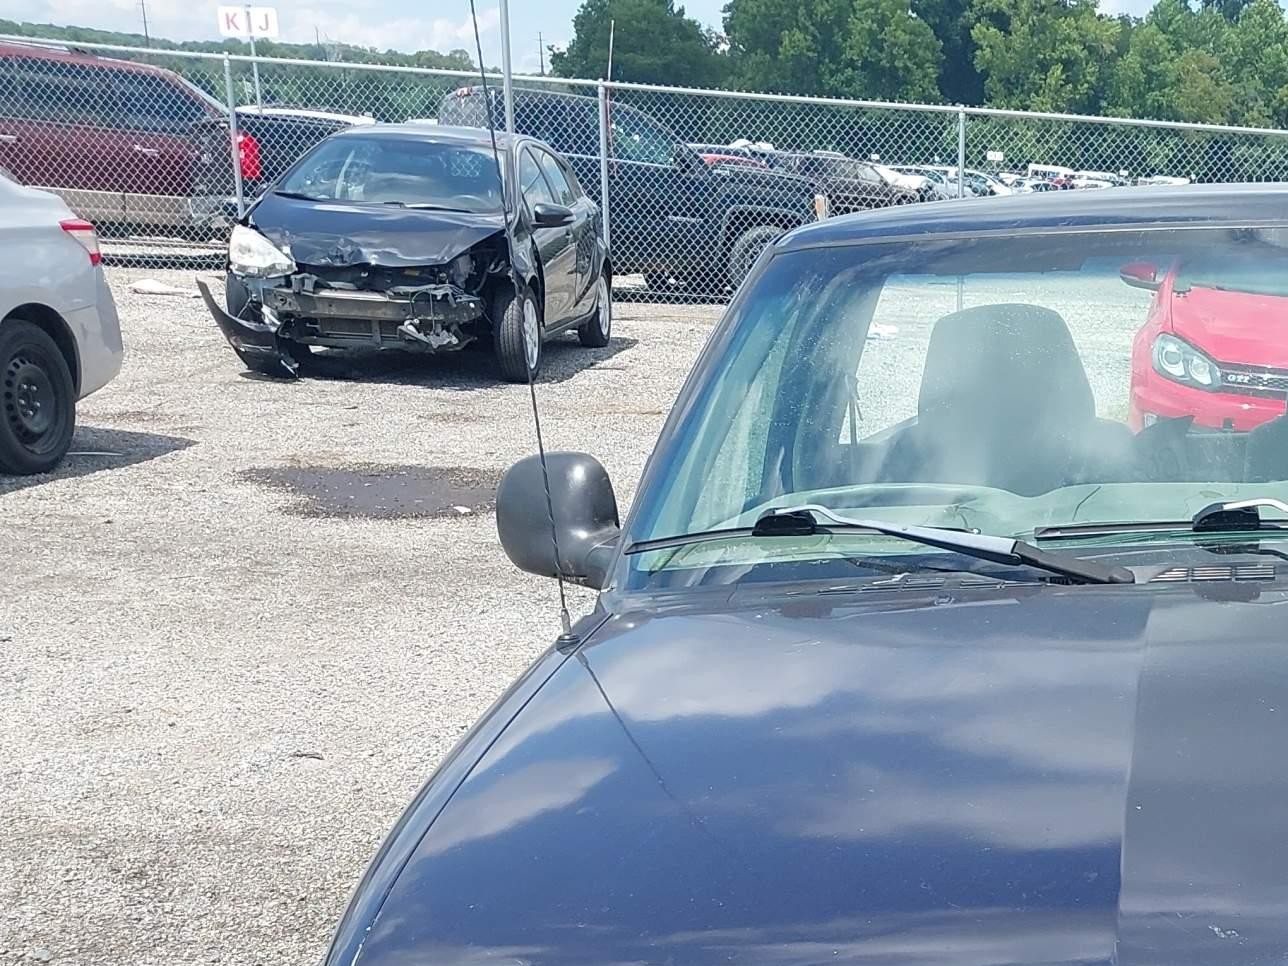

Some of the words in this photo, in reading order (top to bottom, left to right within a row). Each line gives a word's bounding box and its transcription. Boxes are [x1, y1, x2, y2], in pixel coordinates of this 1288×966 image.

[225, 12, 241, 31] K
[258, 13, 270, 32] J
[1227, 374, 1250, 384] GTI
